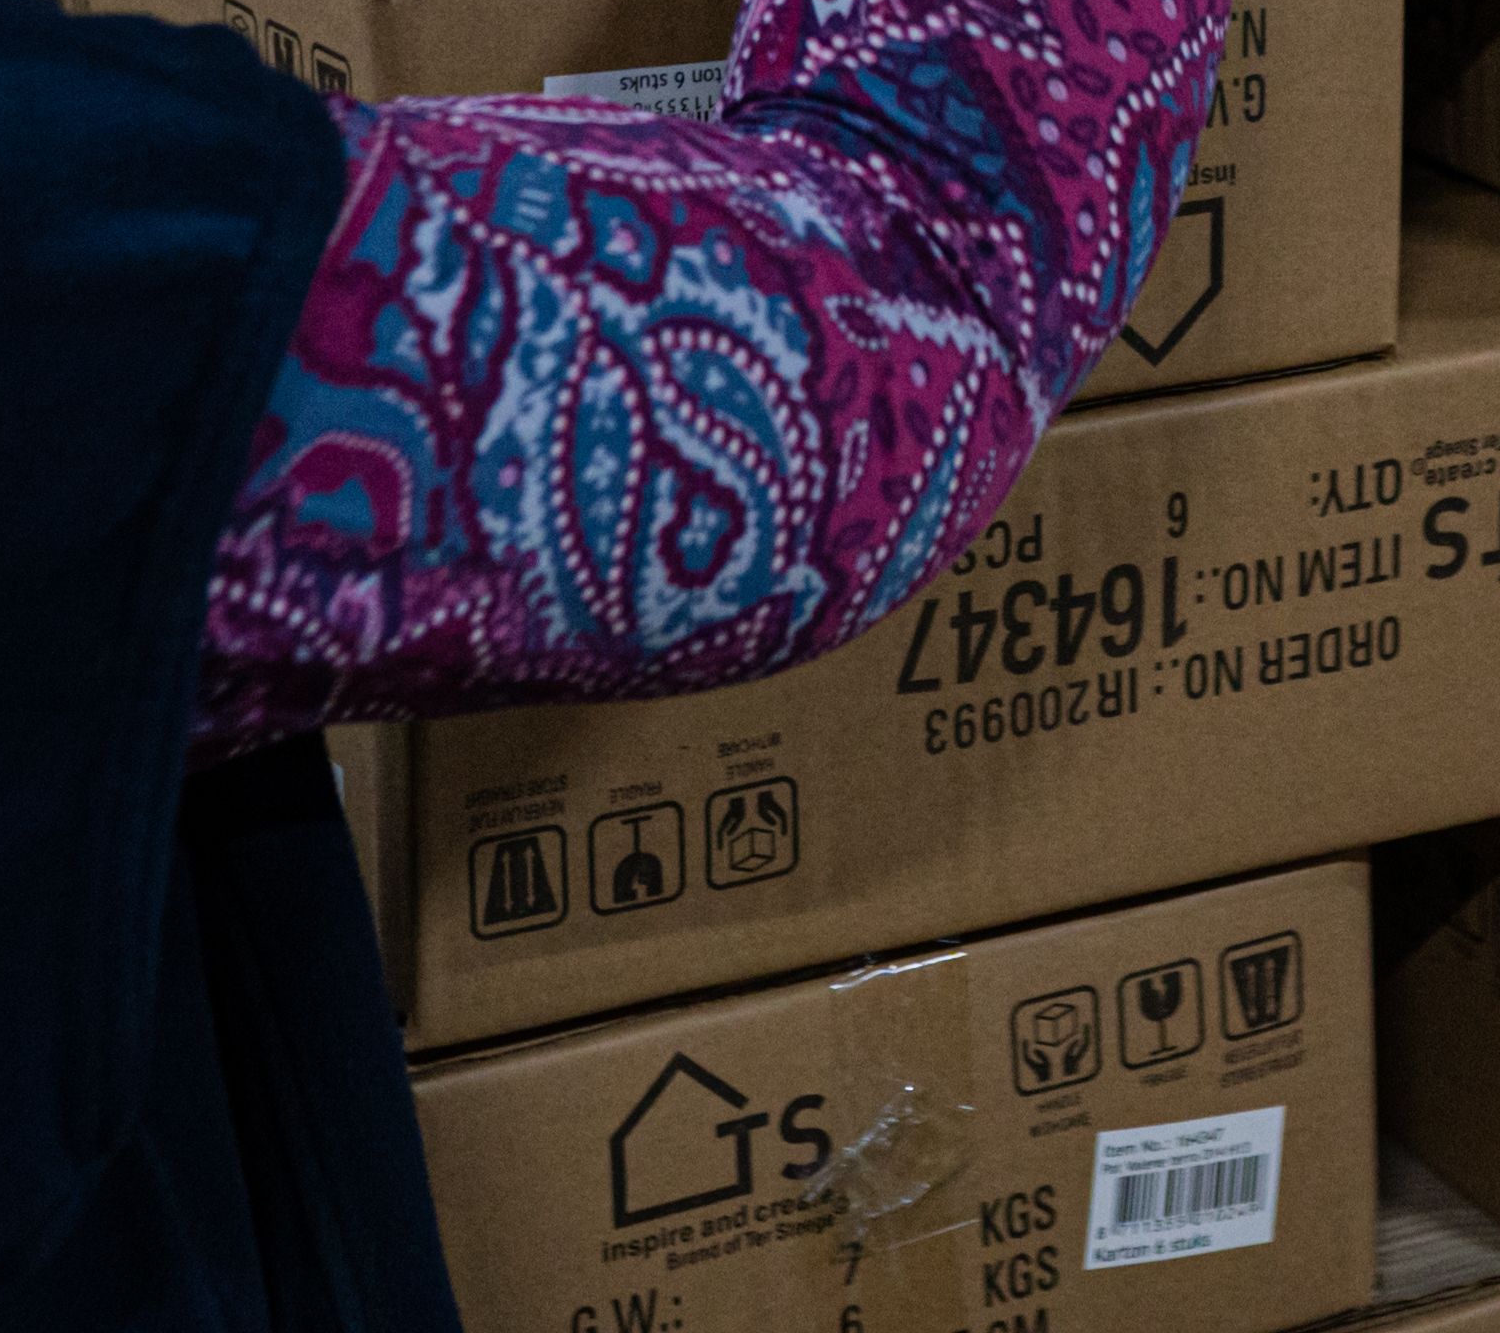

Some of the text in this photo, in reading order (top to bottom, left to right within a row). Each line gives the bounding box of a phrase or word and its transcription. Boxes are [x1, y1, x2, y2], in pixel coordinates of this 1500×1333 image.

[620, 70, 684, 91] 6 stuks
[1168, 458, 1401, 538] QTY: 6
[1300, 533, 1400, 597] ITEM
[897, 556, 1187, 694] 164347
[1261, 614, 1400, 684] ORDER
[926, 667, 1138, 754] IR200993
[603, 1218, 694, 1261] inspire
[980, 1185, 1055, 1247] KGS
[983, 1248, 1059, 1306] KGS
